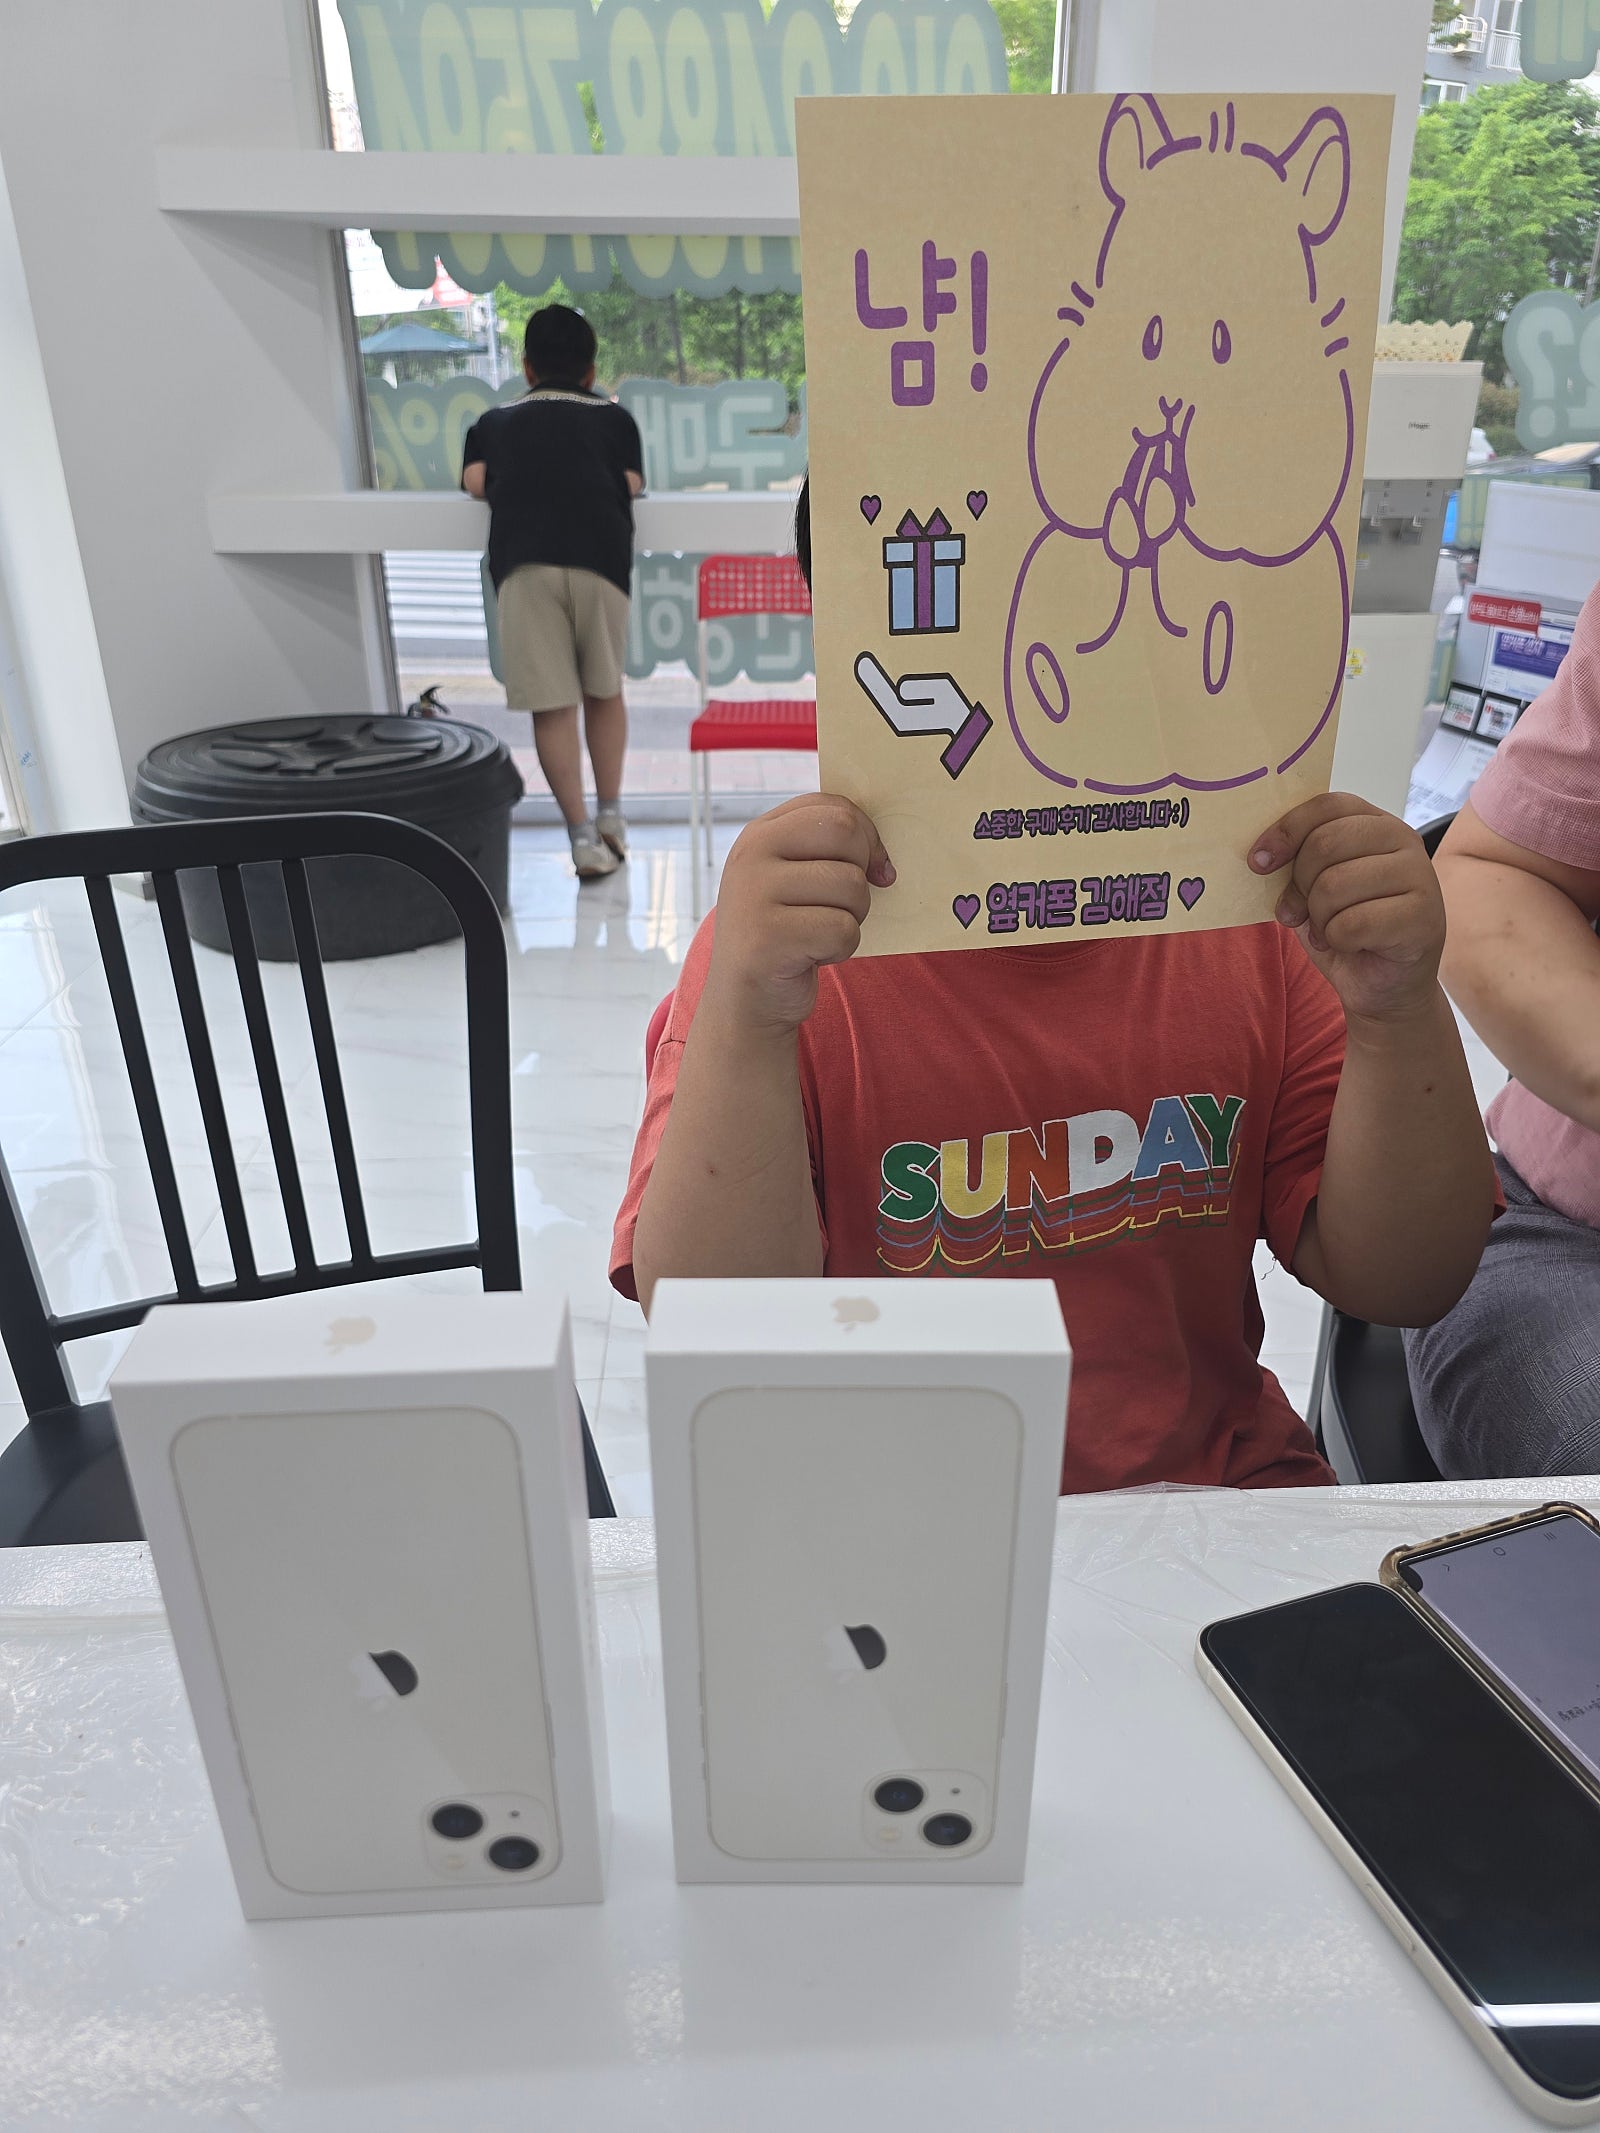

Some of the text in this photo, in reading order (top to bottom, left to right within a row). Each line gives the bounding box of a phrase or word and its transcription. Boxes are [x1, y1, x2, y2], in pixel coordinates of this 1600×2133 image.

[855, 240, 988, 406] 냠!
[973, 808, 1025, 839] 소중한
[1025, 807, 1058, 837] 구매
[1059, 804, 1092, 835] 후기
[986, 871, 1171, 934] 옆커폰 김해점
[877, 1093, 1247, 1224] SUNDAY
